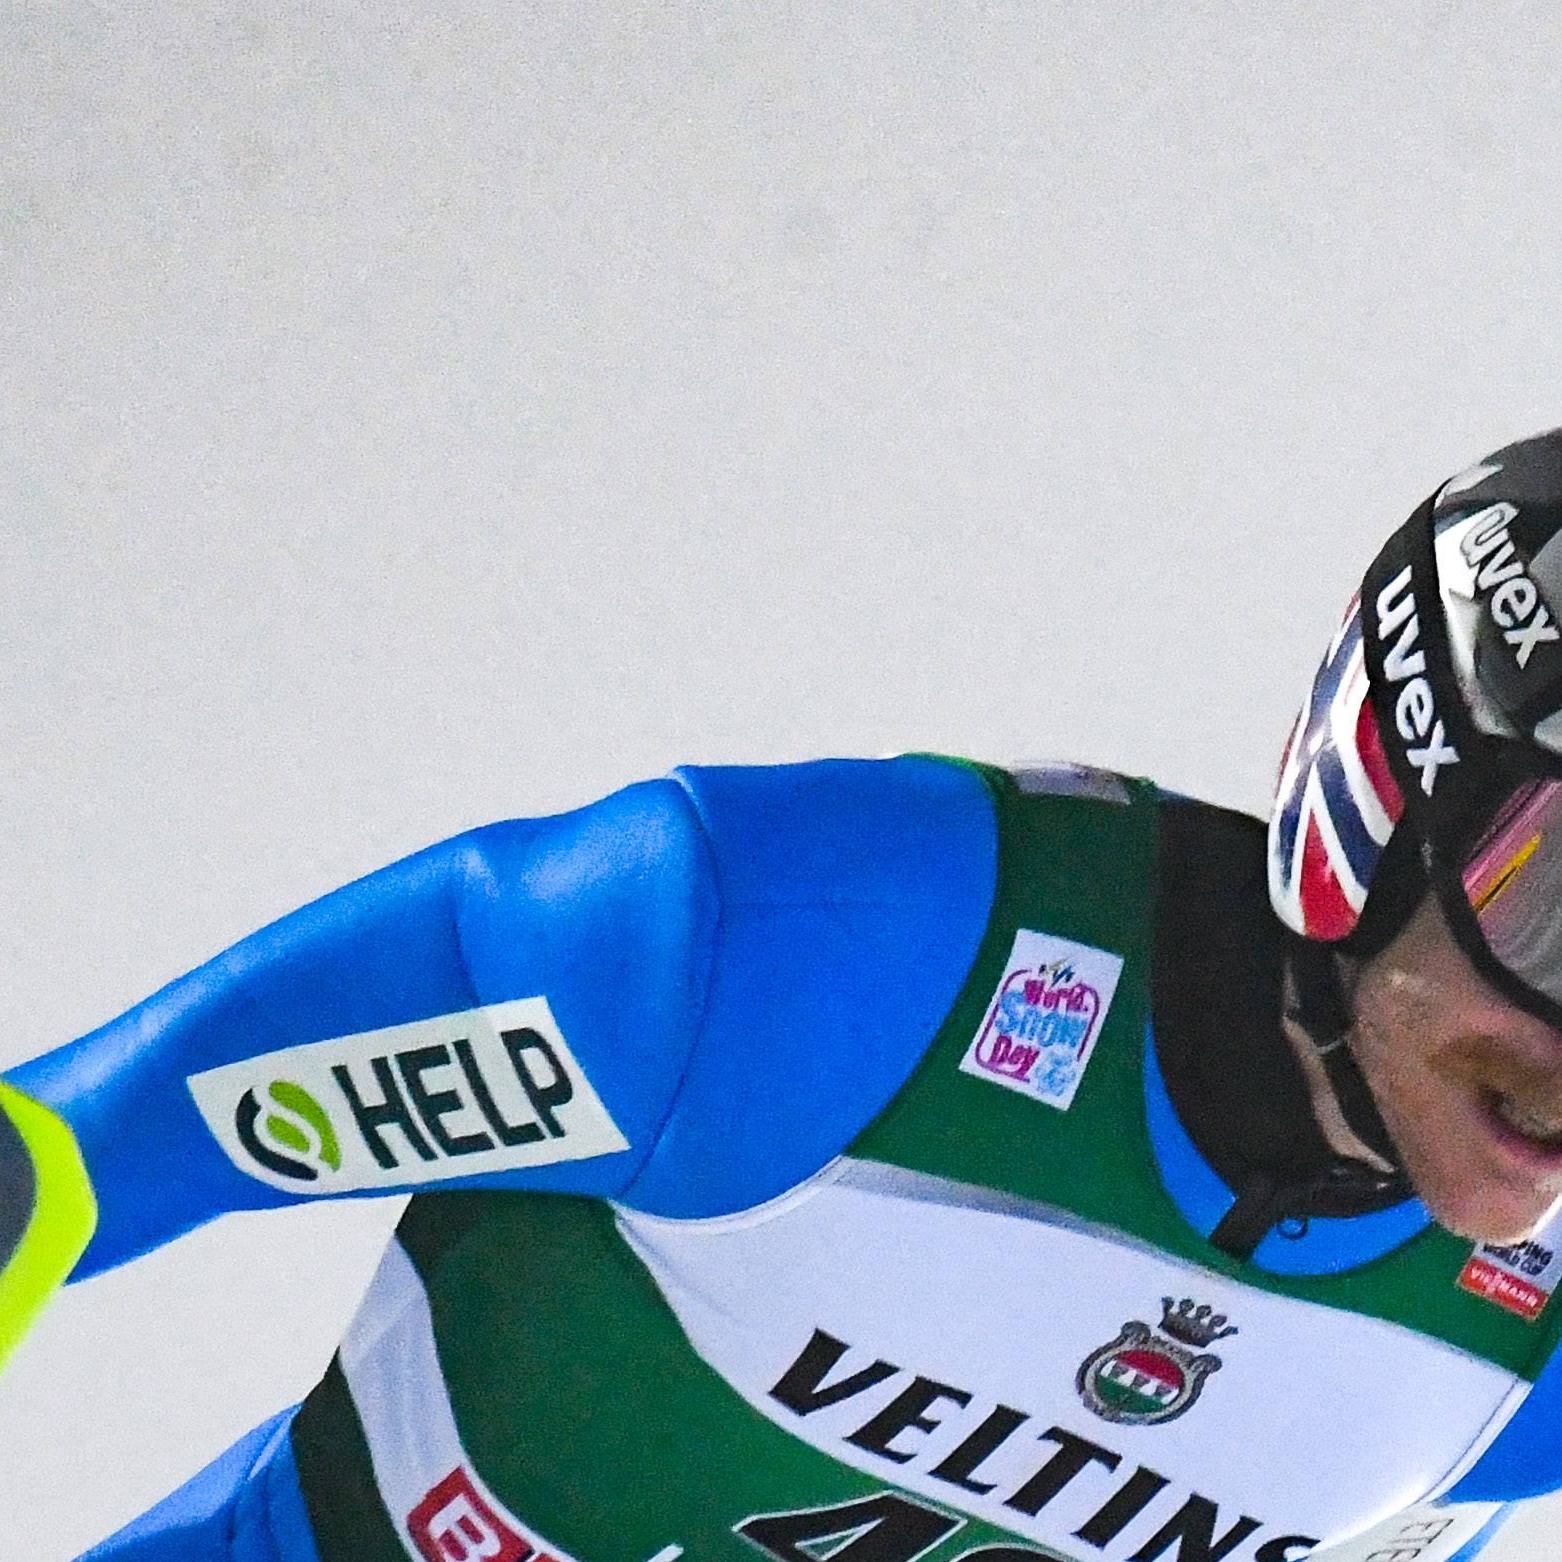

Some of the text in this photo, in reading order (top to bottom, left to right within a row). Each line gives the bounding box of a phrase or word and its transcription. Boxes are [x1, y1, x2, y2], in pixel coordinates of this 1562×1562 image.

[1460, 501, 1561, 670] uvex
[1376, 564, 1461, 797] uvex
[330, 1026, 573, 1170] HELP
[990, 1033, 1041, 1082] Day
